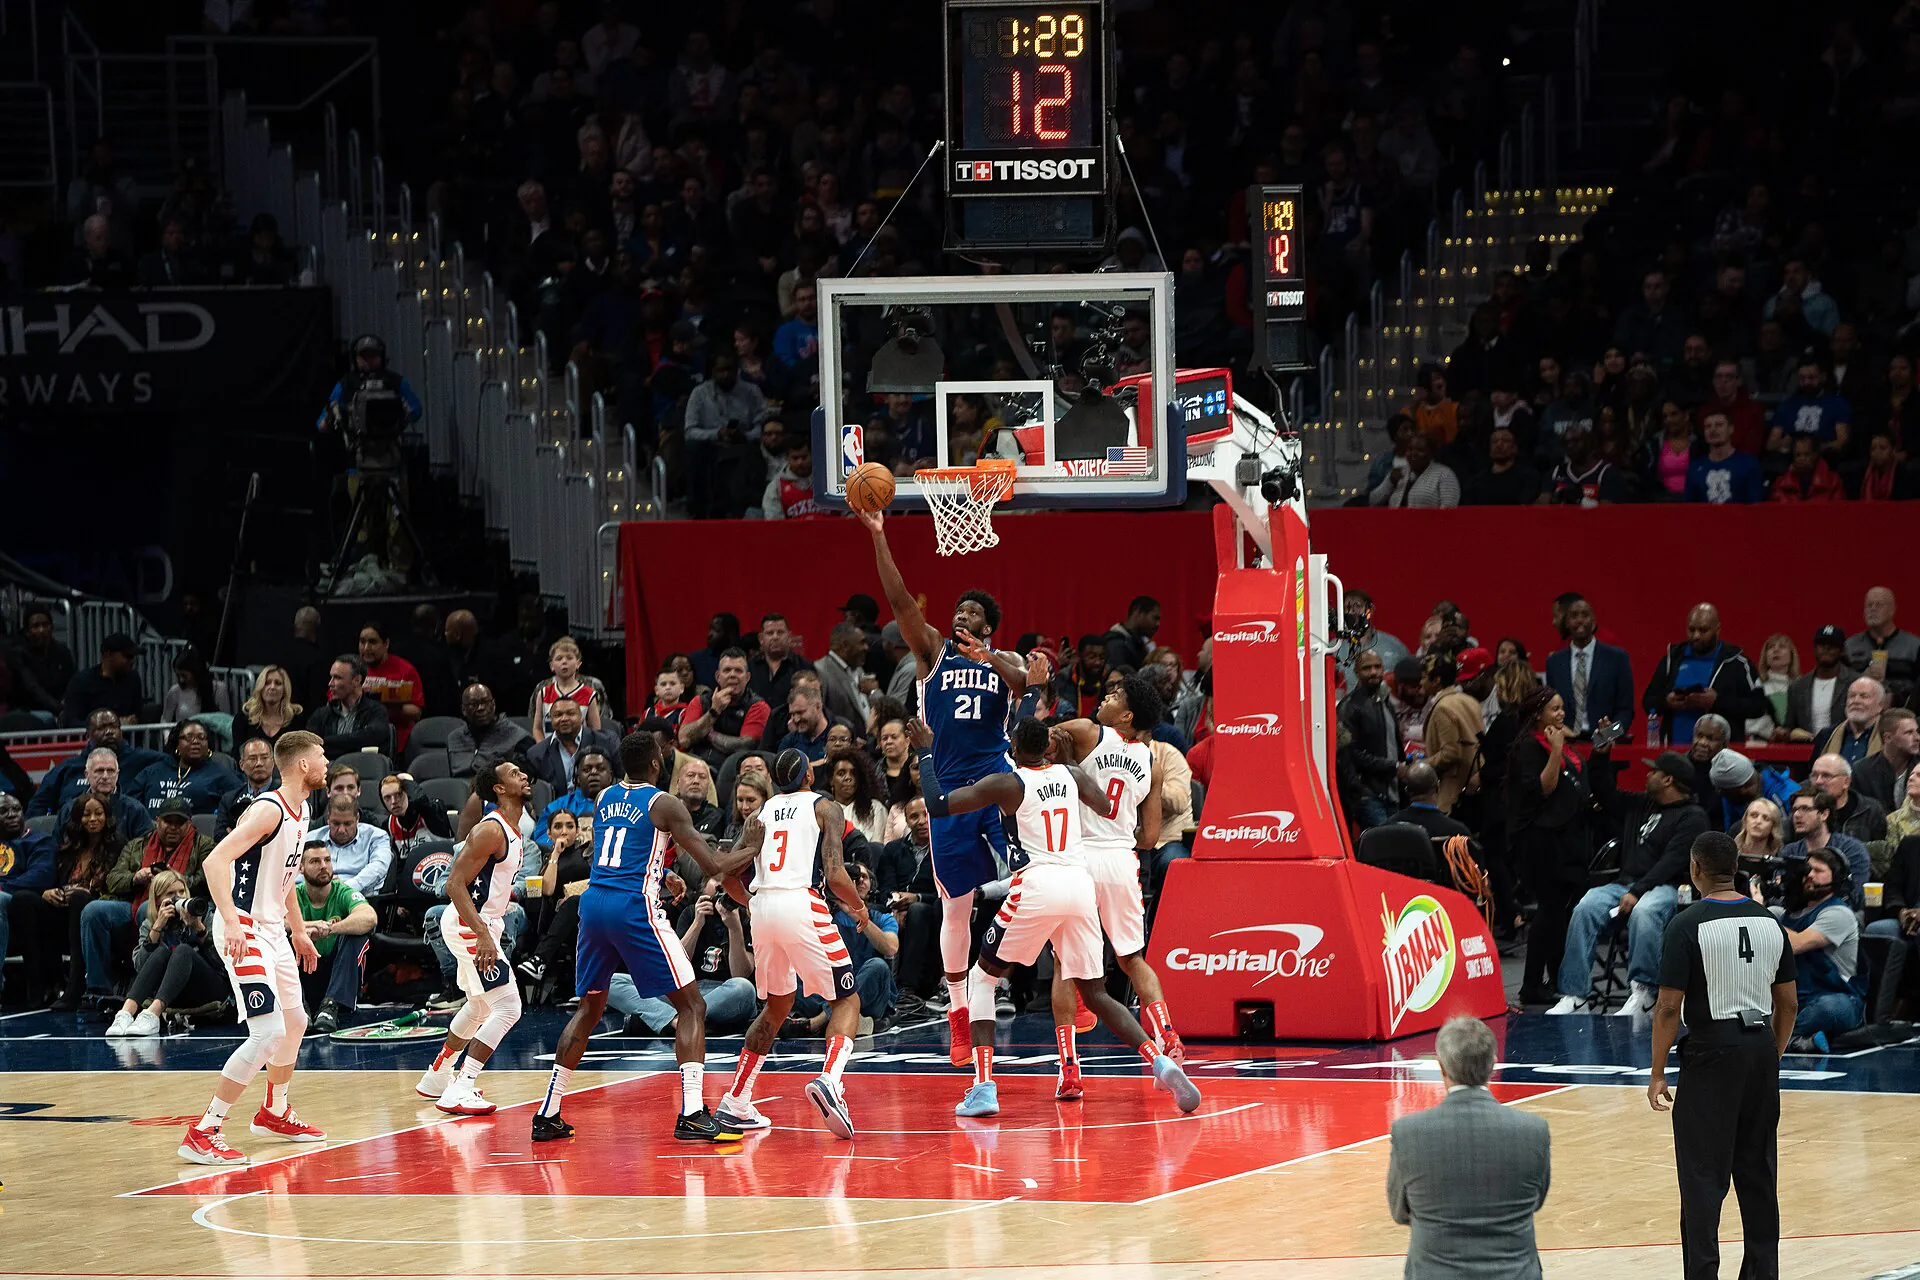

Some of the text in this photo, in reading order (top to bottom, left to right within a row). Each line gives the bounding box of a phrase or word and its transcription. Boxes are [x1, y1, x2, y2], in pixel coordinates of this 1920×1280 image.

[1012, 14, 1084, 58] 1:29
[1012, 64, 1072, 140] 12
[994, 159, 1096, 180] TISSOT
[941, 668, 999, 694] PHILA
[954, 694, 982, 720] 21
[1095, 753, 1146, 784] HACHIMURA
[1036, 782, 1067, 802] BONGA
[600, 802, 632, 823] ENNIS
[774, 807, 798, 822] BEAL
[1040, 807, 1069, 852] 17
[420, 853, 453, 866] WASHINGTO
[597, 826, 627, 868] 11
[769, 830, 788, 872] 3
[1738, 926, 1755, 964] 4
[1383, 907, 1450, 1034] LIBMAN
